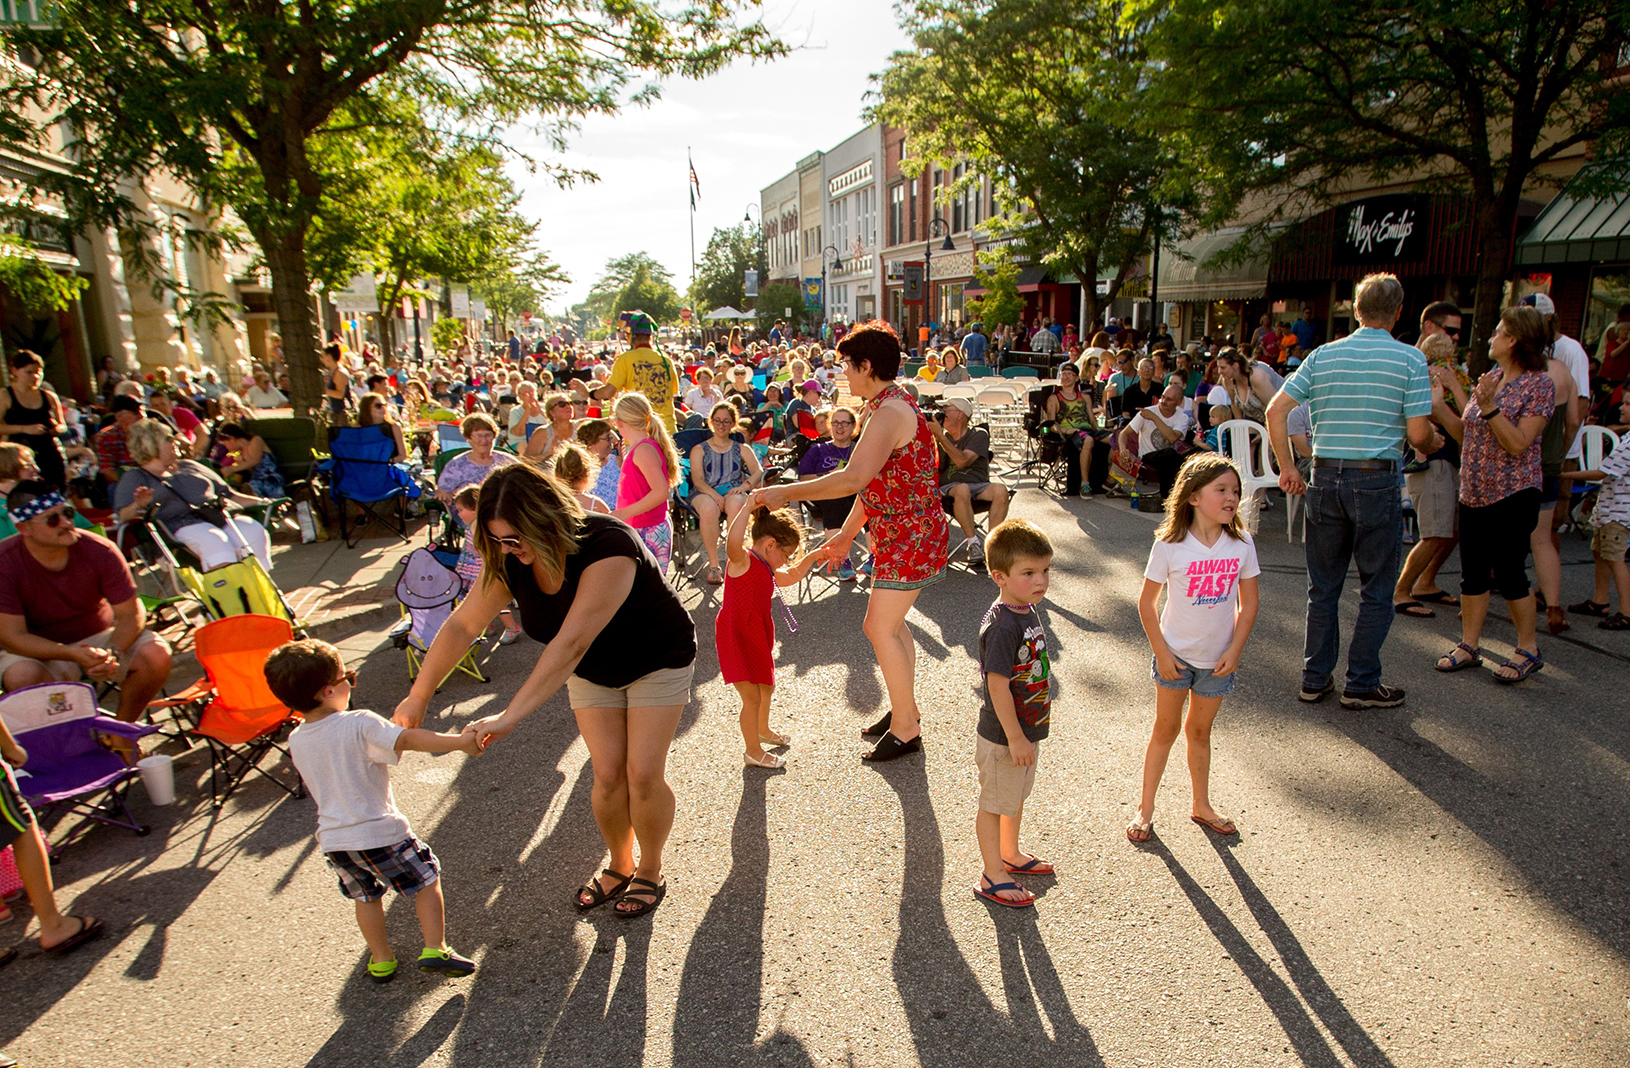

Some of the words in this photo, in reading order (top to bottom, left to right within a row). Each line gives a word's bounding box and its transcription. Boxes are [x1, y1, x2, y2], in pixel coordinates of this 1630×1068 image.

[1346, 204, 1377, 254] Max
[1376, 209, 1415, 257] Emily's
[1185, 557, 1240, 576] ALWAYS
[1185, 573, 1239, 598] FAST
